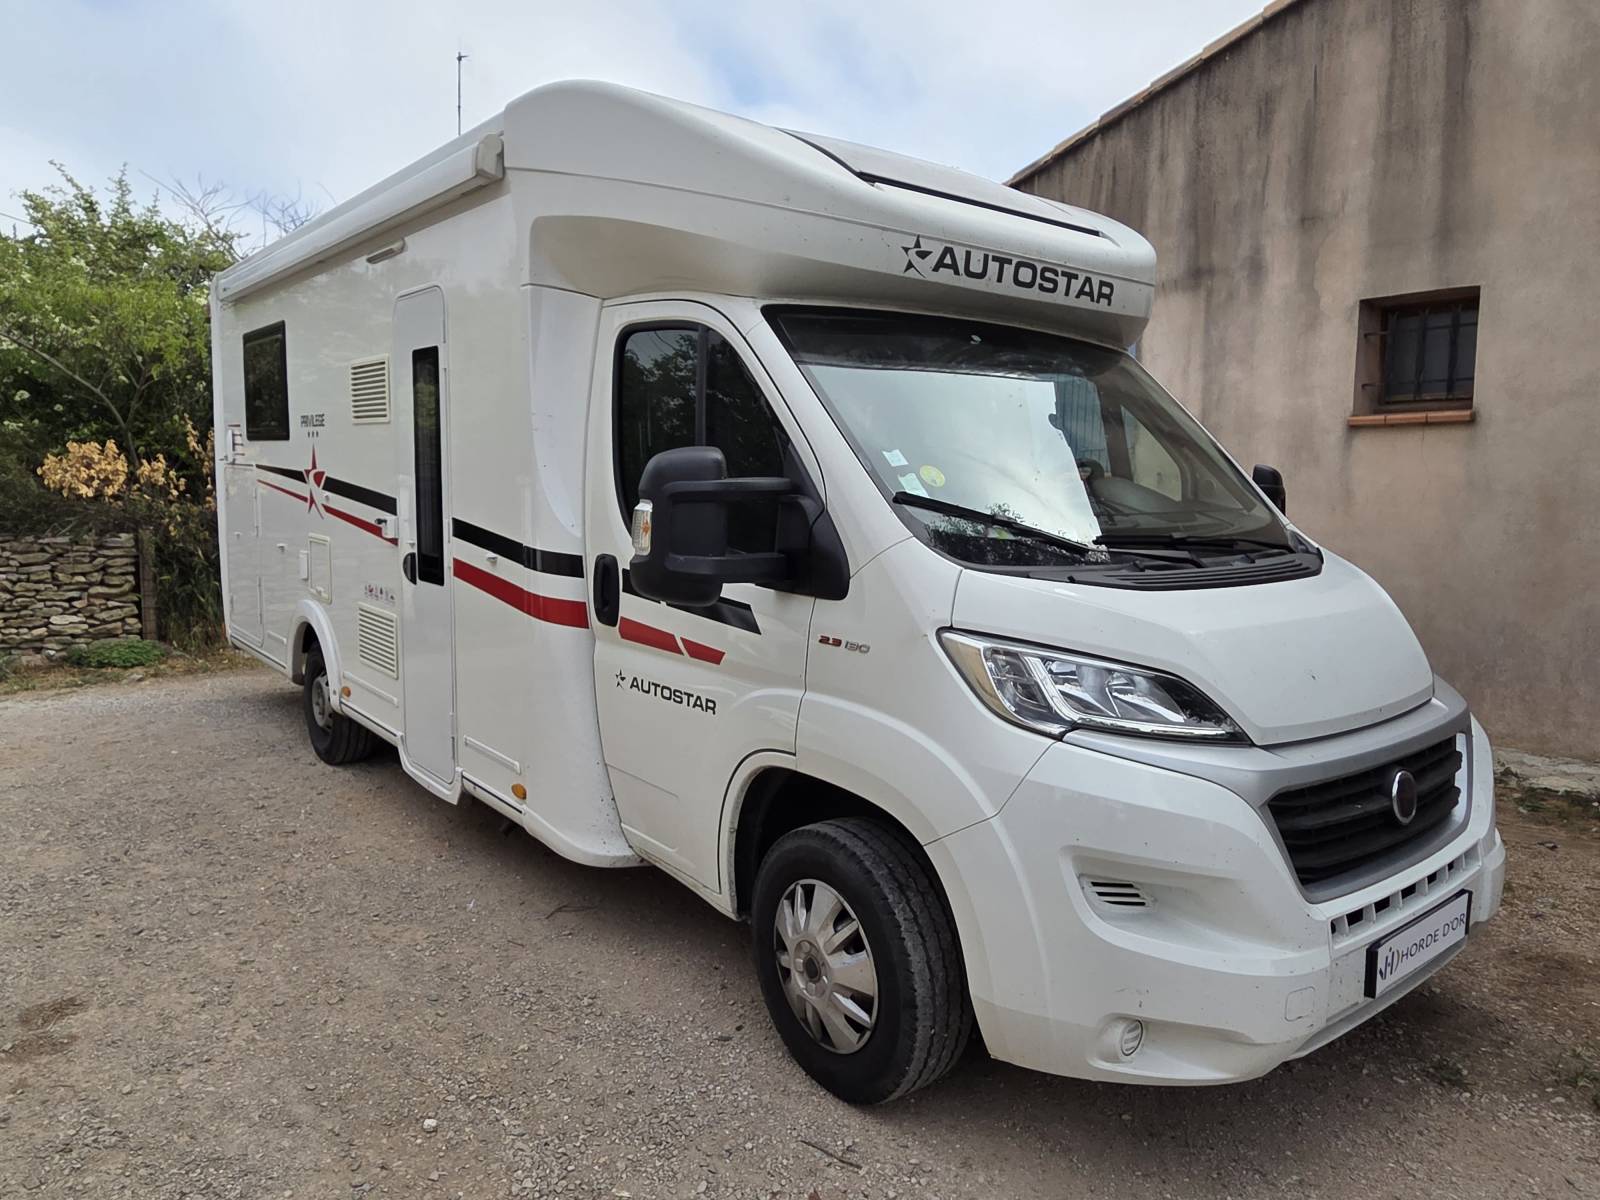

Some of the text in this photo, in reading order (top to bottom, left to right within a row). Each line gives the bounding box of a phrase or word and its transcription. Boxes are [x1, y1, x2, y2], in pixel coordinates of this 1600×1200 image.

[932, 246, 1115, 307] AUTOSTAR
[629, 676, 717, 716] AUTOSTAR
[1400, 928, 1440, 963] HORDE
[1442, 912, 1466, 938] D'OR
